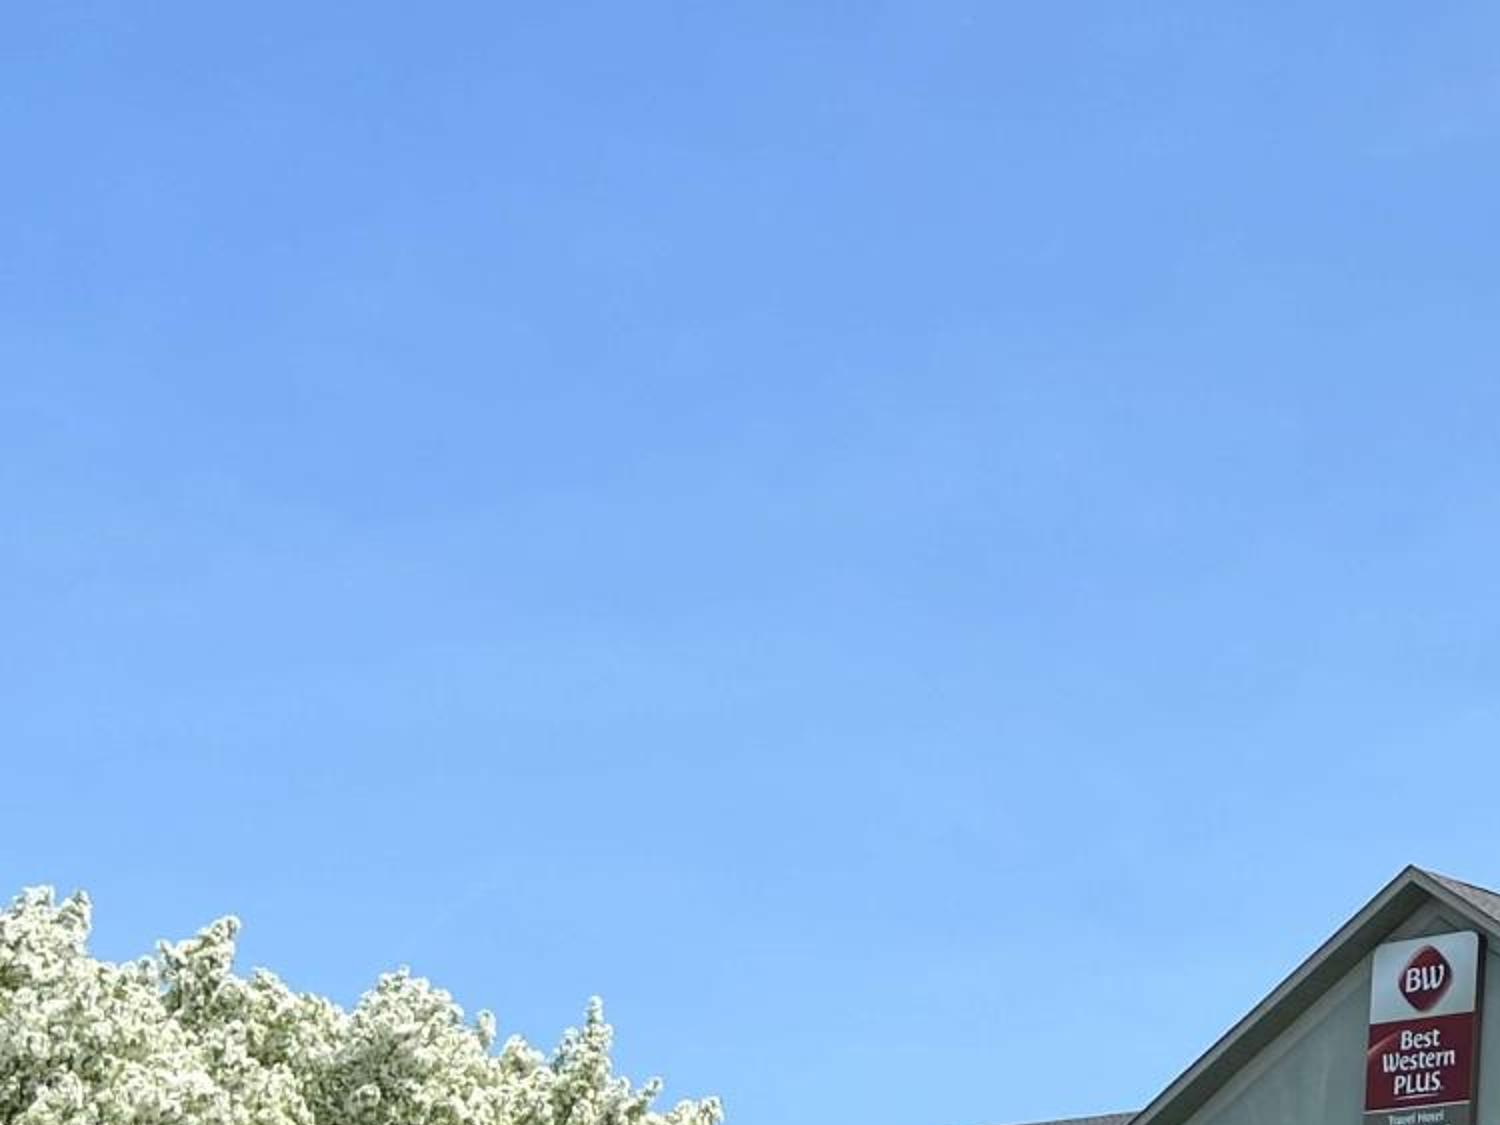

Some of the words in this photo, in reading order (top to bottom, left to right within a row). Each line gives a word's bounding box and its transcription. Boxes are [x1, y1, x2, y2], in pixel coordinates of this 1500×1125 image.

[1405, 964, 1444, 993] BW
[1401, 1029, 1441, 1050] Best
[1382, 1049, 1455, 1073] Western
[1393, 1071, 1442, 1095] PLUS
